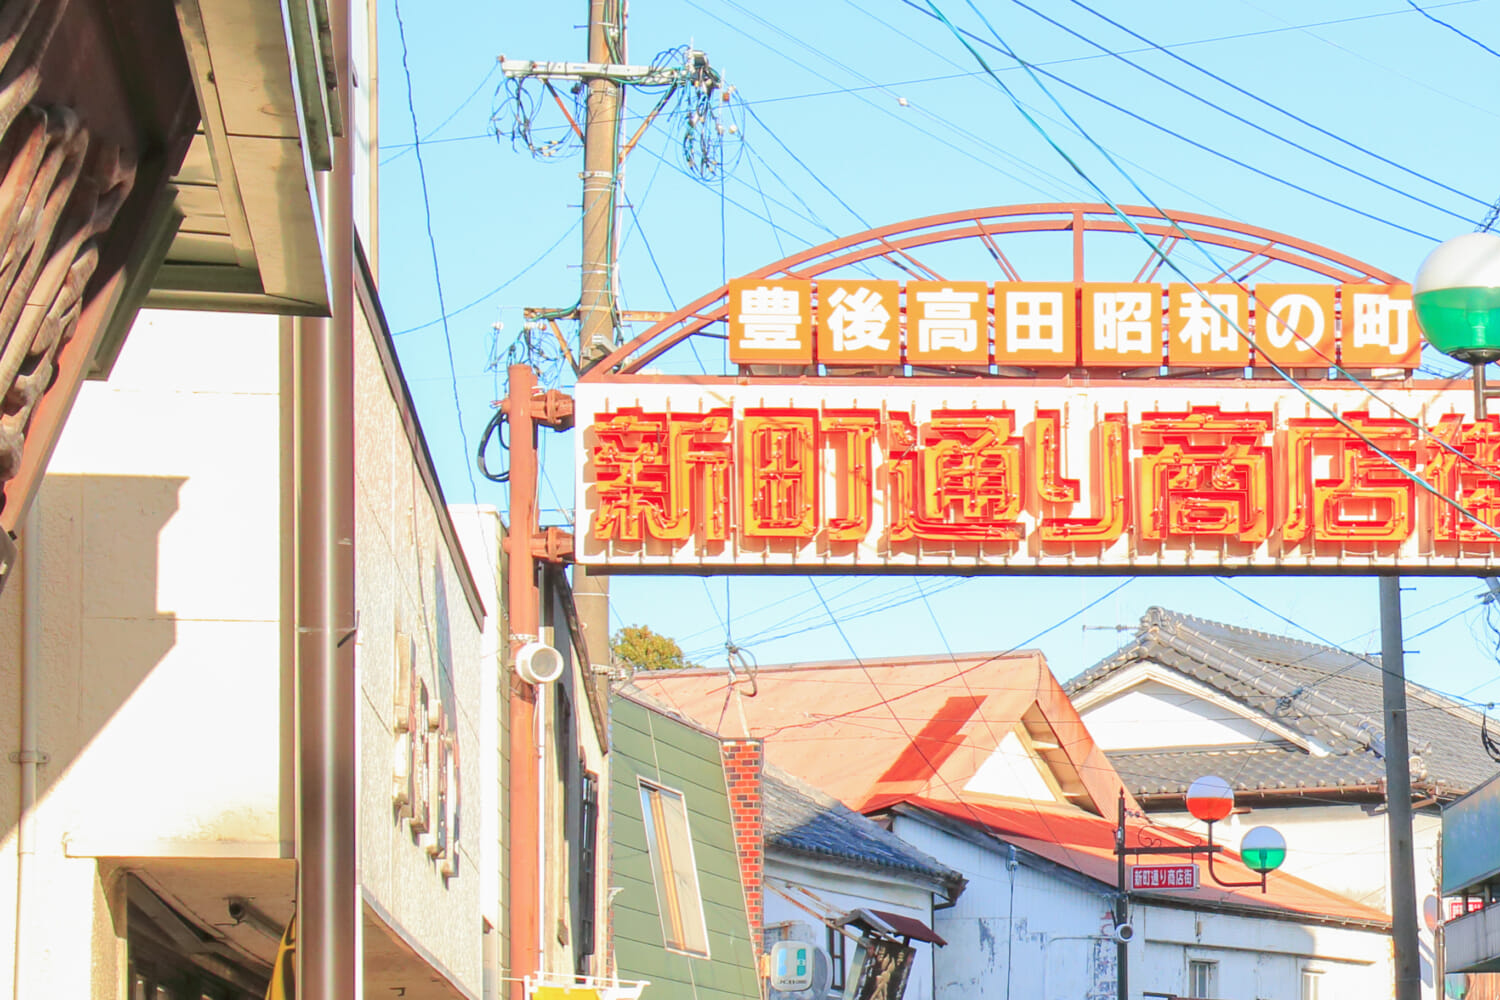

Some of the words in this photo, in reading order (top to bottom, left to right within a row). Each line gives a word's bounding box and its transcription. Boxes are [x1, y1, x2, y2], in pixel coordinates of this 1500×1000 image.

[737, 286, 1414, 357] 豊後高田昭和の町
